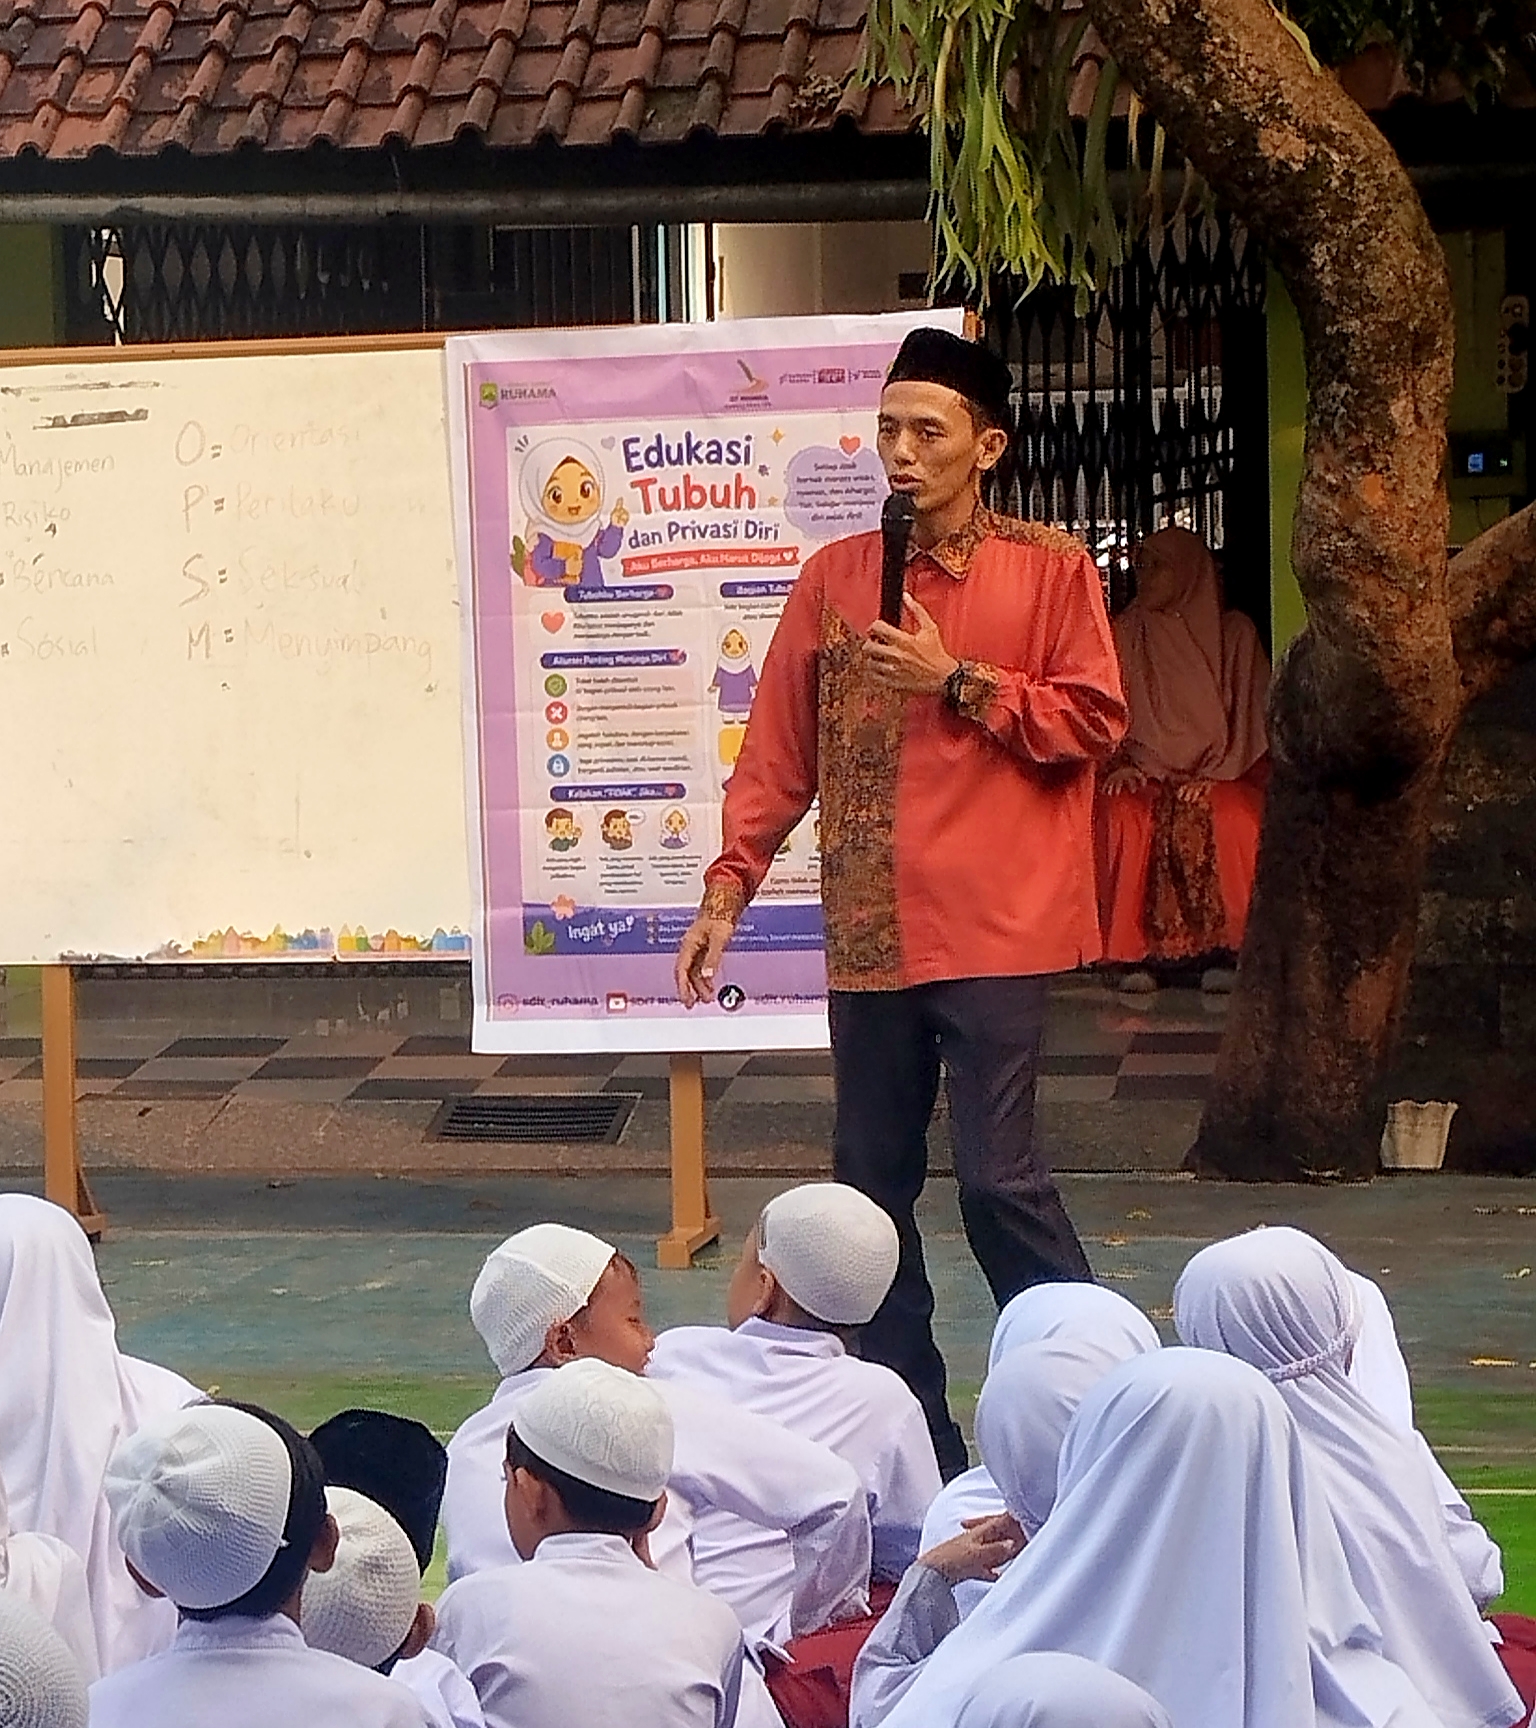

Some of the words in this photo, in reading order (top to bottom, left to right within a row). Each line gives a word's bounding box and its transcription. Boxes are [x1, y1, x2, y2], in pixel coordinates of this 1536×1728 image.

[500, 387, 557, 400] RUHAMA
[622, 431, 753, 473] Edukasi
[630, 472, 756, 516] Tubuh
[2, 500, 71, 528] Risiko
[628, 529, 663, 550] dan
[667, 519, 740, 543] Privasi
[744, 518, 780, 542] Diri
[630, 561, 650, 573] Aku
[651, 557, 699, 571] Berharga,
[699, 555, 719, 565] Aku
[568, 918, 606, 944] Ingat
